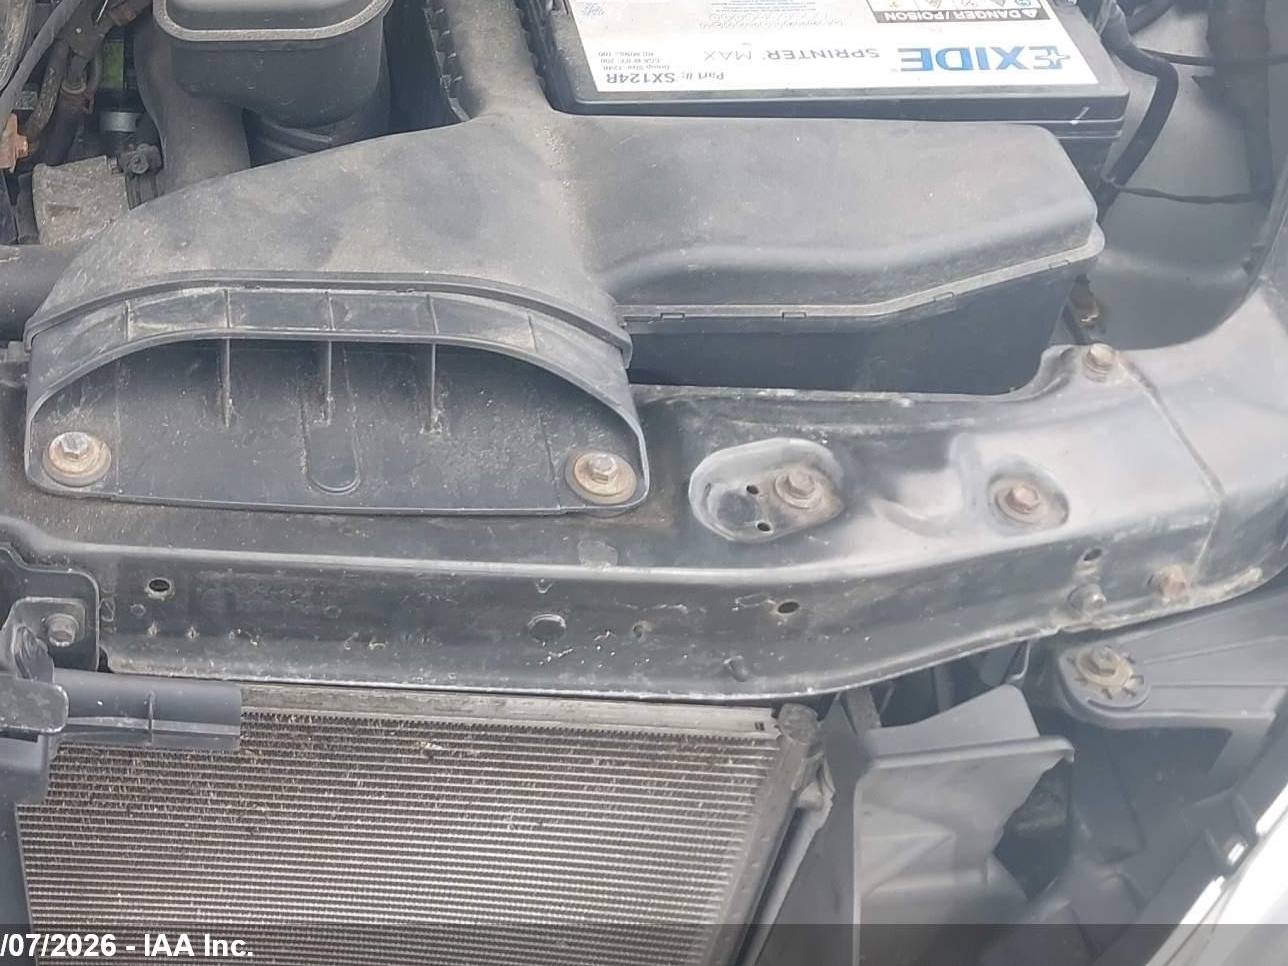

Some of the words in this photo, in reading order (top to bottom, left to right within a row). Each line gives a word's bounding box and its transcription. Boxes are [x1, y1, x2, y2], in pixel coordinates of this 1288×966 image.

[953, 9, 1022, 20] DANGER
[703, 49, 752, 61] MAX
[766, 47, 881, 61] SPRINTER
[898, 45, 1070, 73] EXIDE
[606, 72, 676, 84] SX124R
[698, 71, 724, 80] Part
